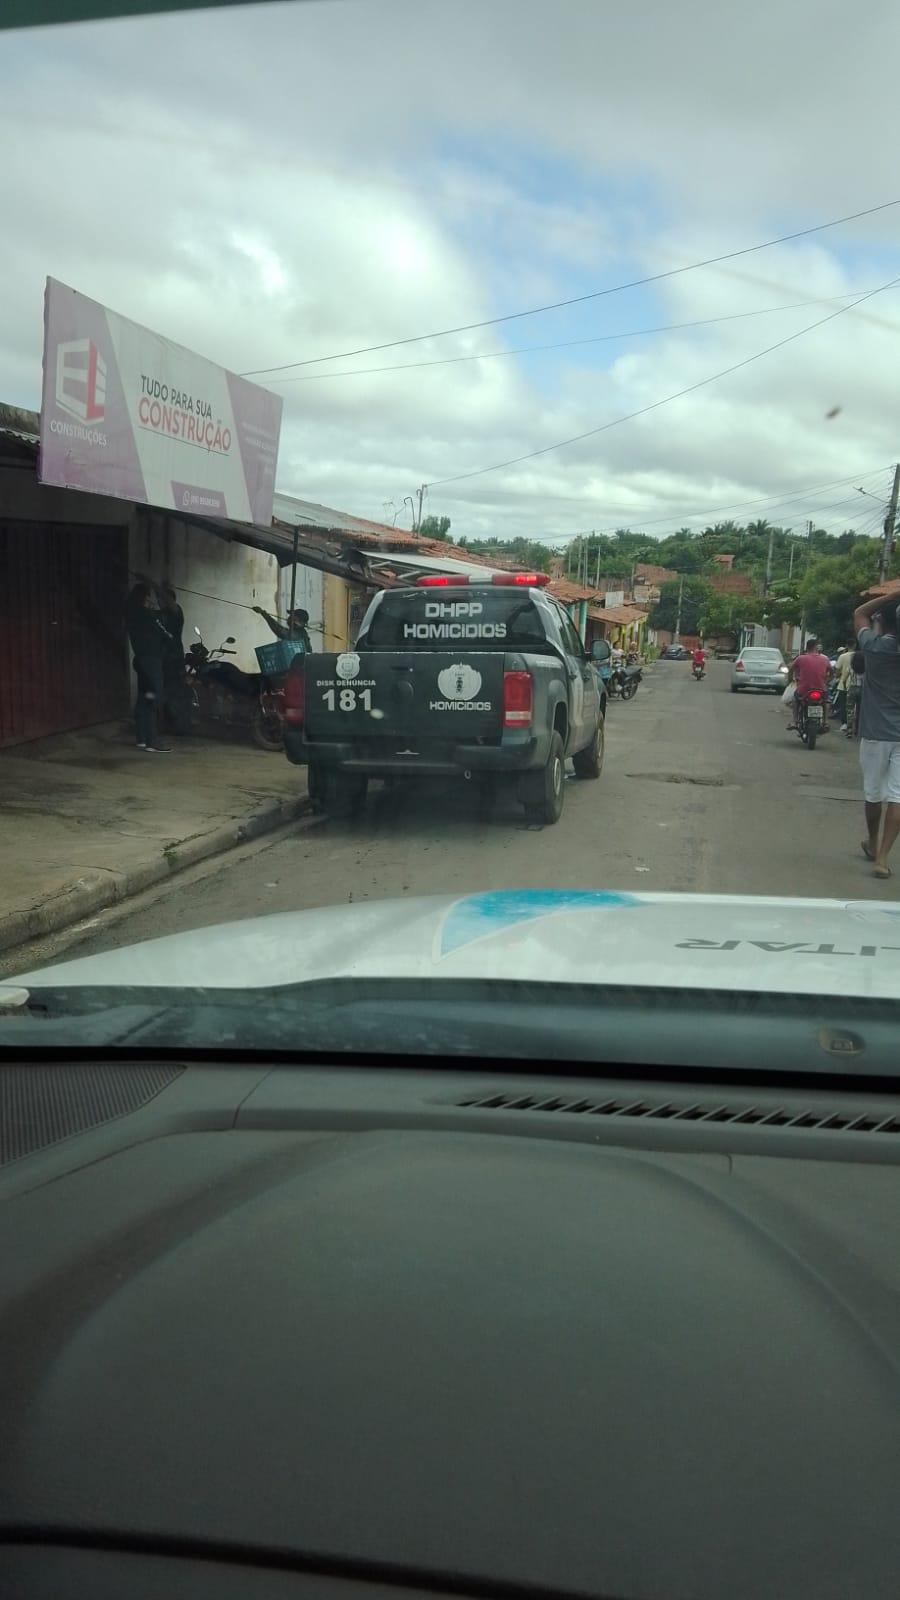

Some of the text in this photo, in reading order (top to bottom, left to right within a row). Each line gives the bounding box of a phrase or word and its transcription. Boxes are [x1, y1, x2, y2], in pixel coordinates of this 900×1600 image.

[140, 375, 212, 419] TUDO PARA SUA
[50, 418, 108, 448] CONSTRUÇÕES
[138, 397, 231, 454] CONSTRUÇÃO
[425, 602, 483, 618] DHPP
[404, 623, 507, 639] HOMICIDIOS
[336, 678, 377, 687] DENÚNCIA
[322, 688, 372, 712] 181
[429, 701, 492, 711] HOMICIDIOS
